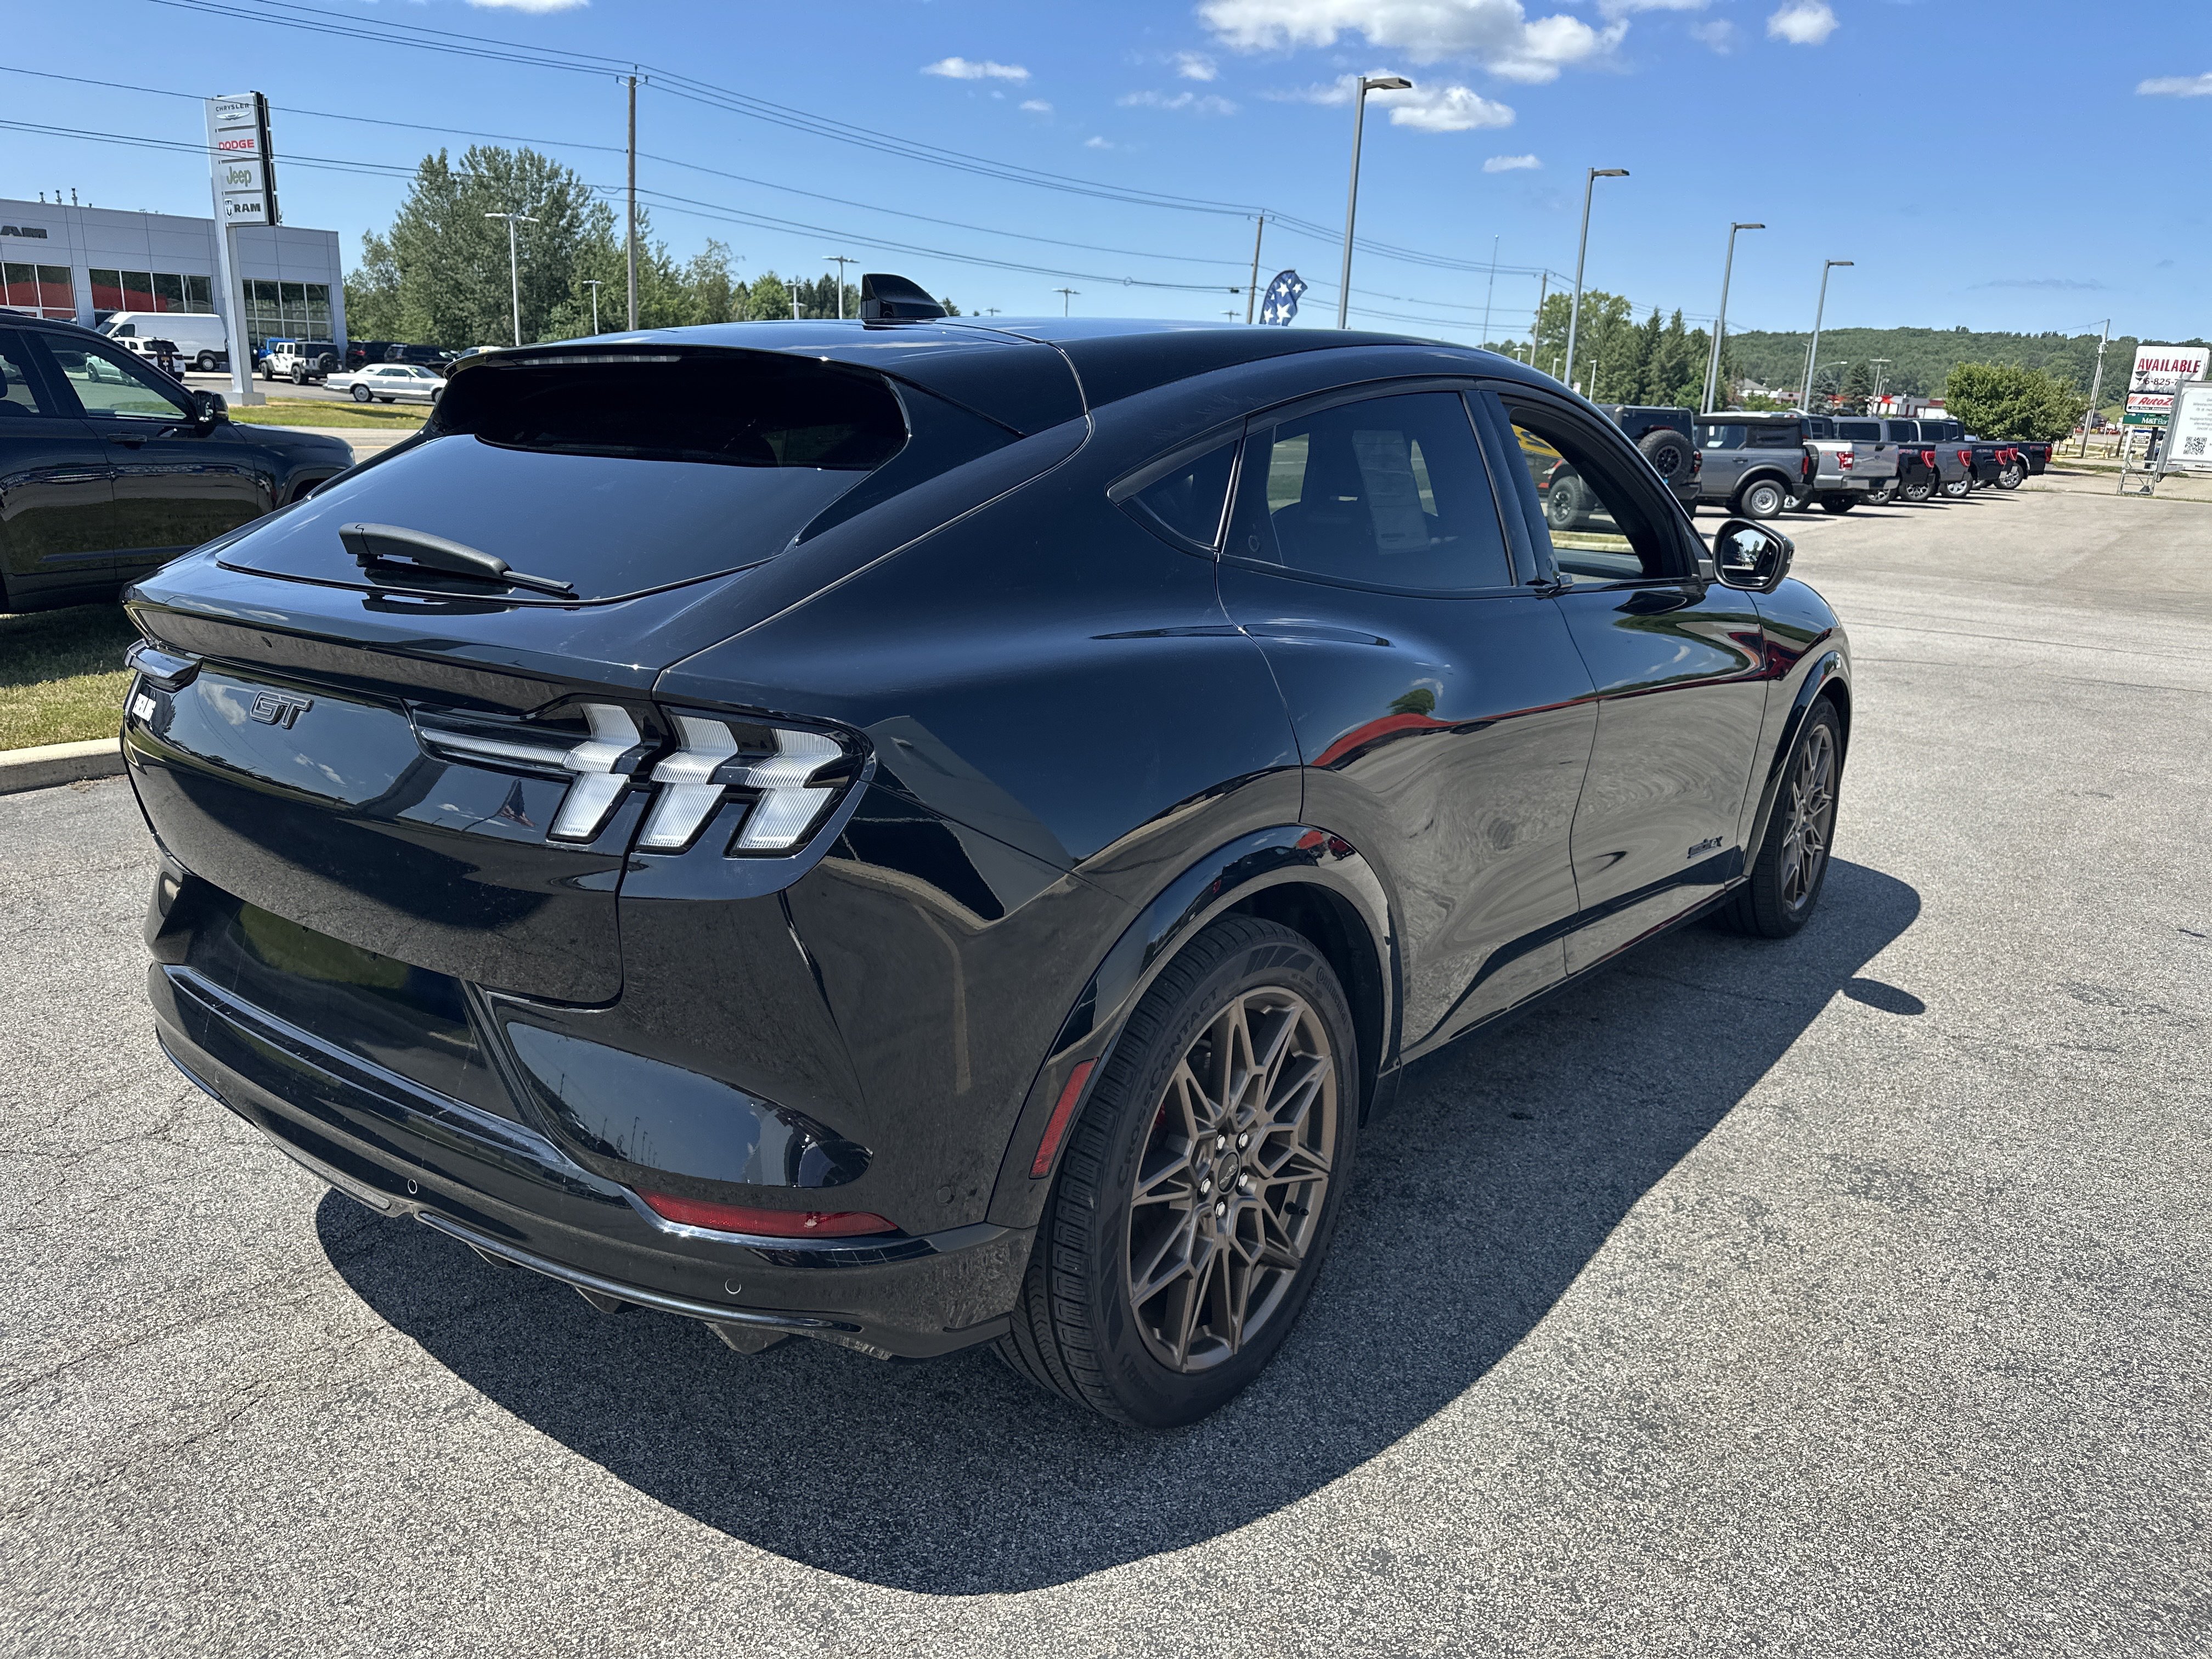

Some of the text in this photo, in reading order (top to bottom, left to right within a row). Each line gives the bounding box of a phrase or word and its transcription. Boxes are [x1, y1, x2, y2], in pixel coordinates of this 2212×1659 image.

[216, 103, 249, 112] CHRYSLER
[218, 139, 254, 150] DODGE
[227, 166, 252, 187] Jeep
[234, 203, 261, 212] RAM
[0, 225, 48, 239] AM
[2137, 358, 2201, 373] AVAILABLE
[2138, 397, 2174, 405] AutoZ
[250, 690, 314, 729] GT
